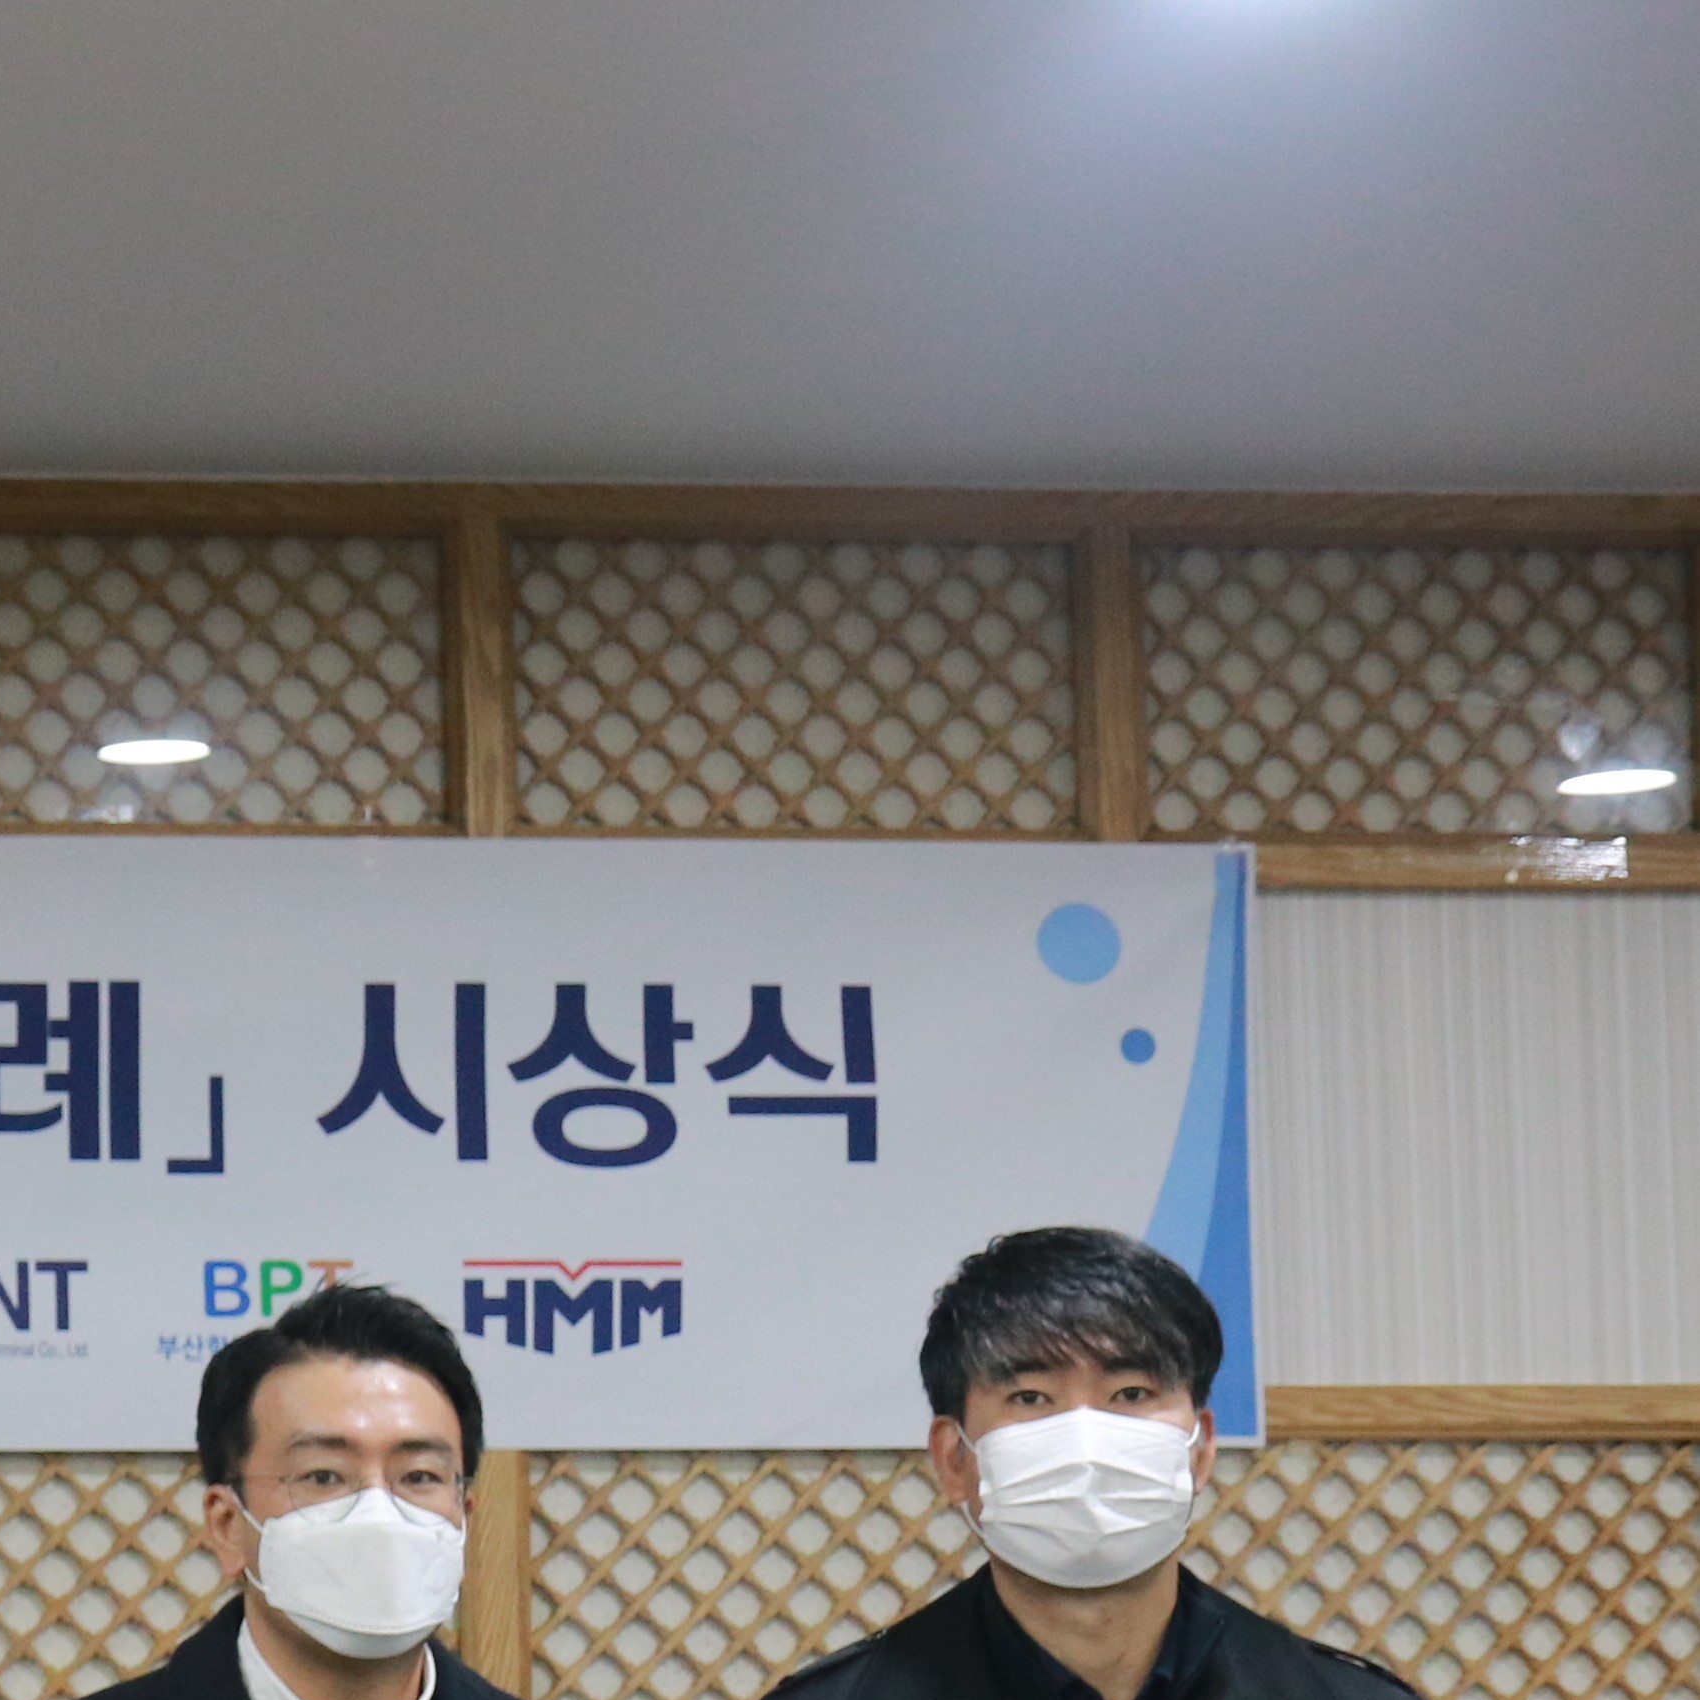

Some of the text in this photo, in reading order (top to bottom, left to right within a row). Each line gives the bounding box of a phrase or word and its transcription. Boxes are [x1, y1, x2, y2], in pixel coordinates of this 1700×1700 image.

[316, 982, 879, 1169] 시상식
[204, 1260, 353, 1317] BPT
[463, 1279, 681, 1355] HMM
